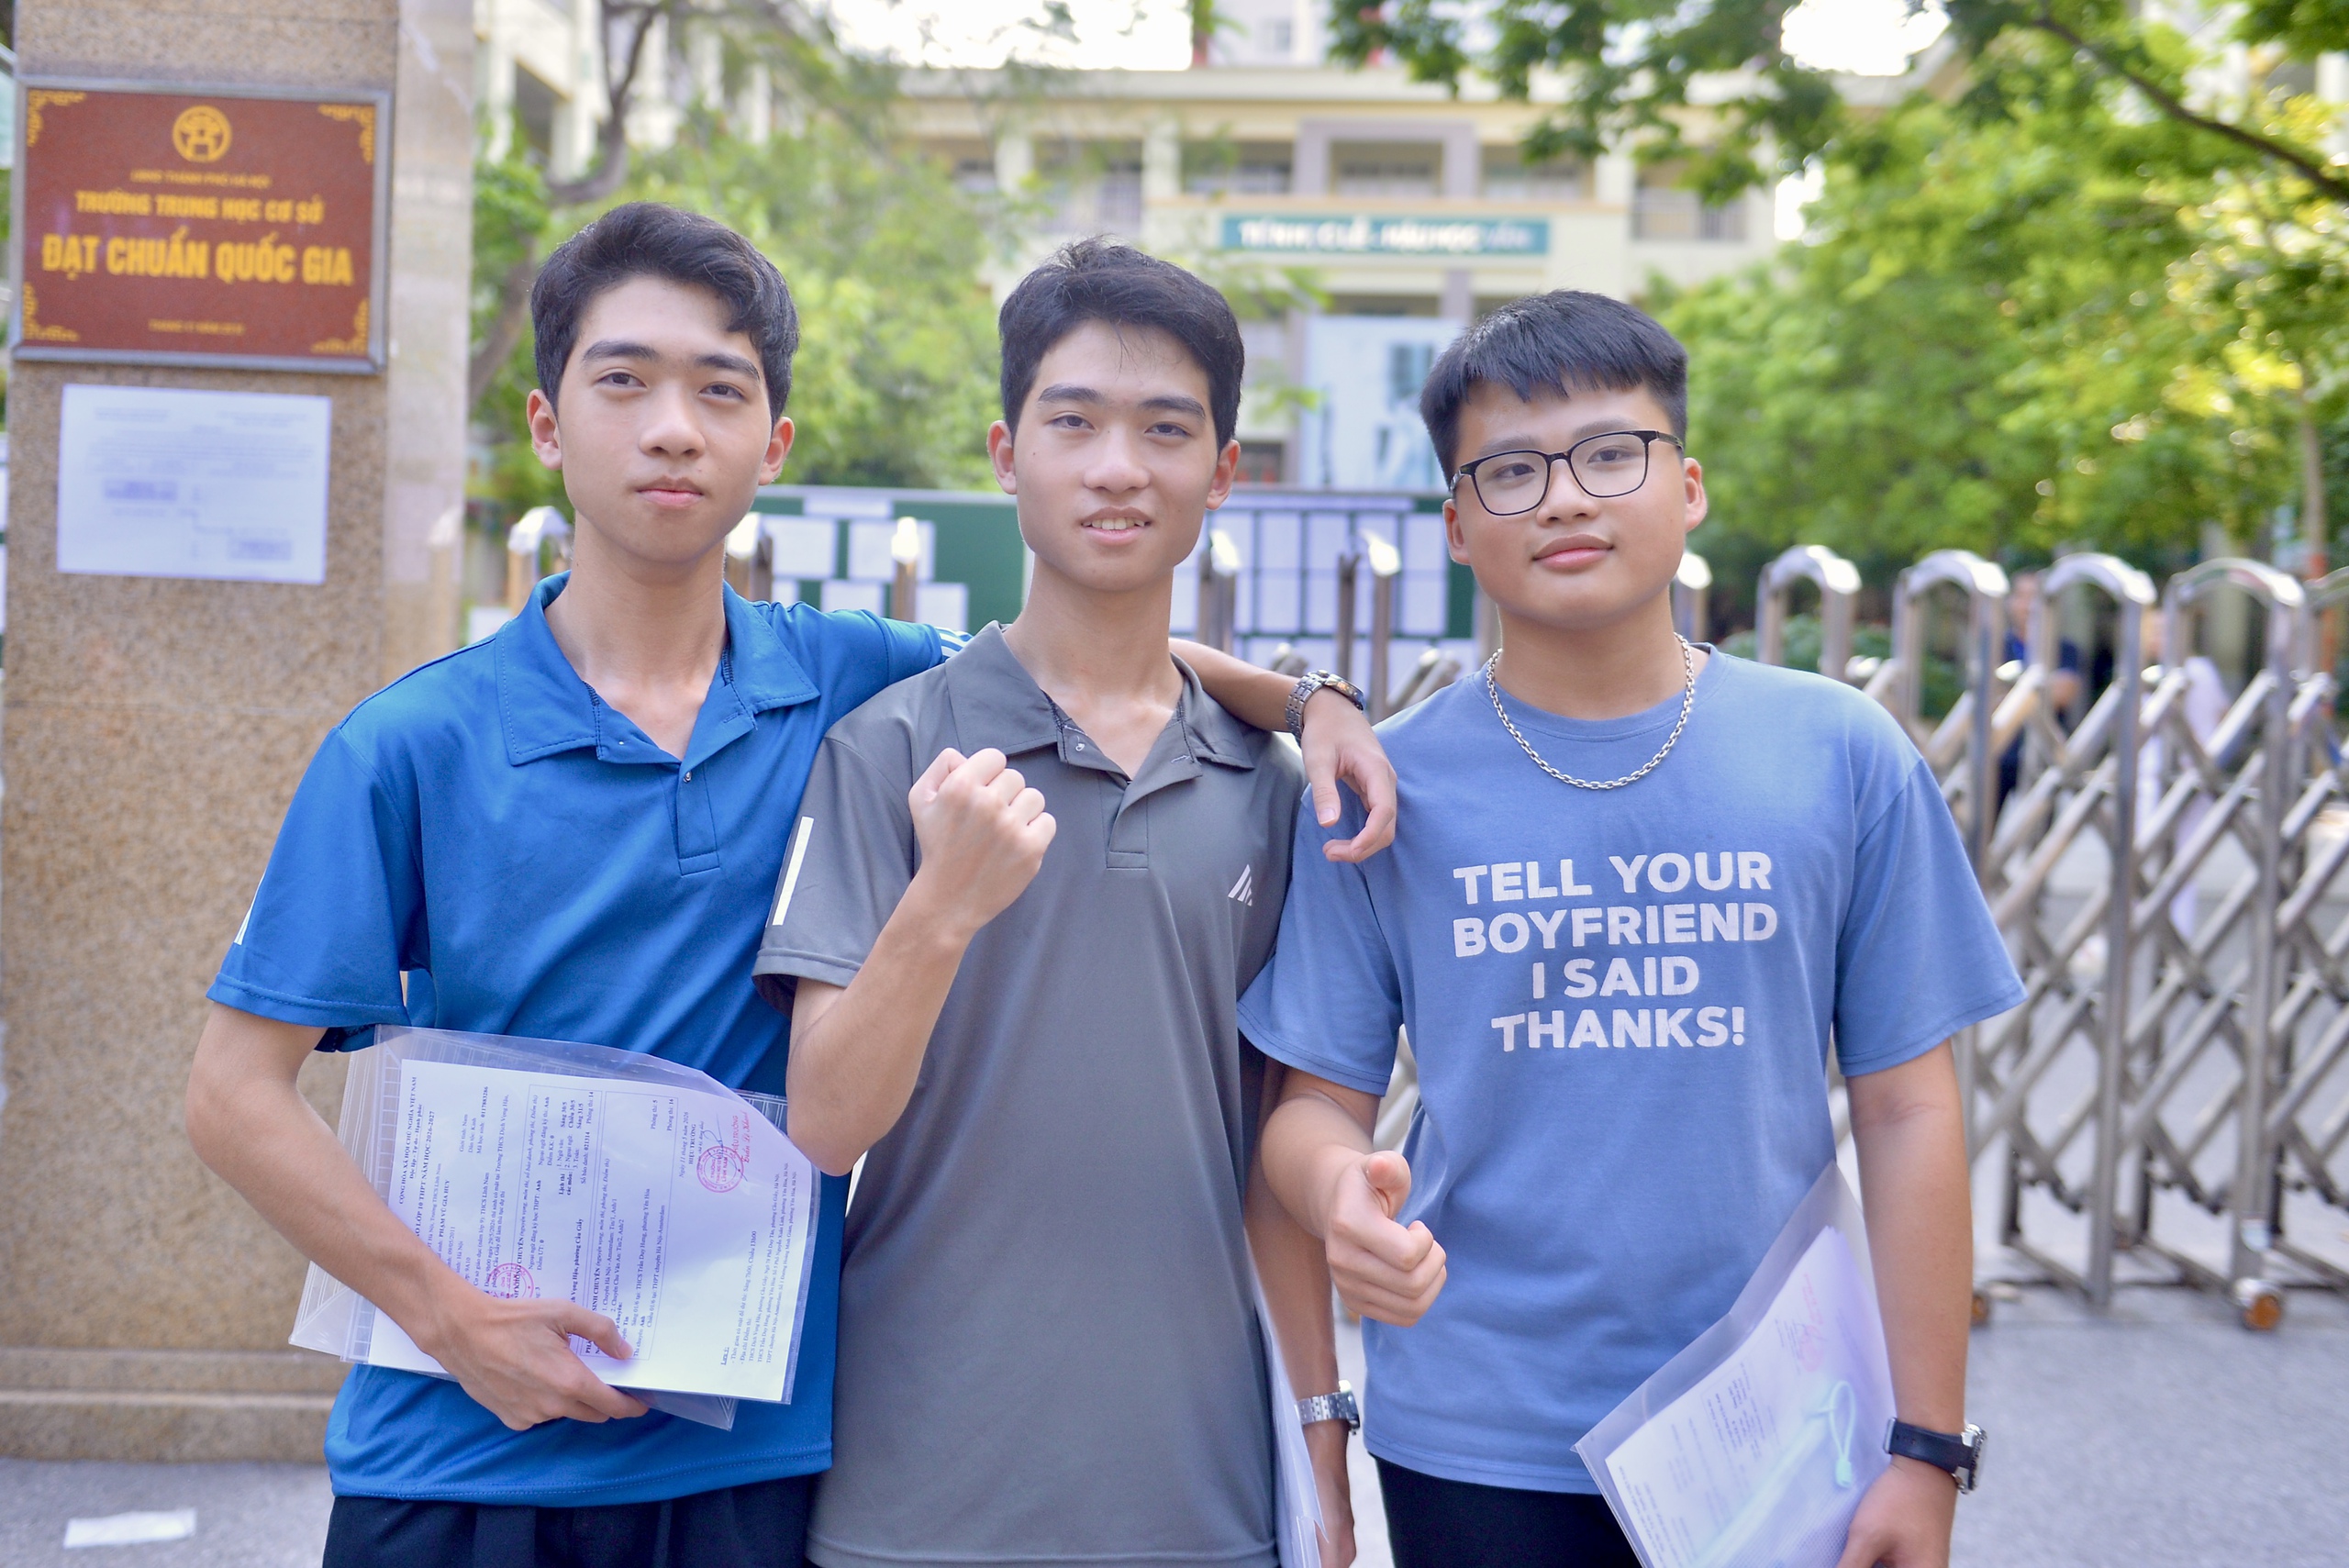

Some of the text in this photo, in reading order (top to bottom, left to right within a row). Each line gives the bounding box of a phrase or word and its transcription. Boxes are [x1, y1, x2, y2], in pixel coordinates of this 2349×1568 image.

[75, 189, 325, 225] TRƯỜNG TRUNG HỌC CƠ SỞ
[42, 233, 100, 281] ĐẠT
[216, 230, 296, 284] QUỐC
[302, 246, 354, 285] GIA
[1453, 851, 1772, 905] TELL YOUR
[1453, 902, 1778, 957] BOYFRIEND
[1532, 955, 1699, 999] I SAID
[1491, 1006, 1745, 1052] THANKS!
[426, 1111, 434, 1141] 2026-2027
[402, 1160, 408, 1168] XÃ
[411, 1145, 417, 1153] Tự
[440, 1207, 446, 1217] VŨ
